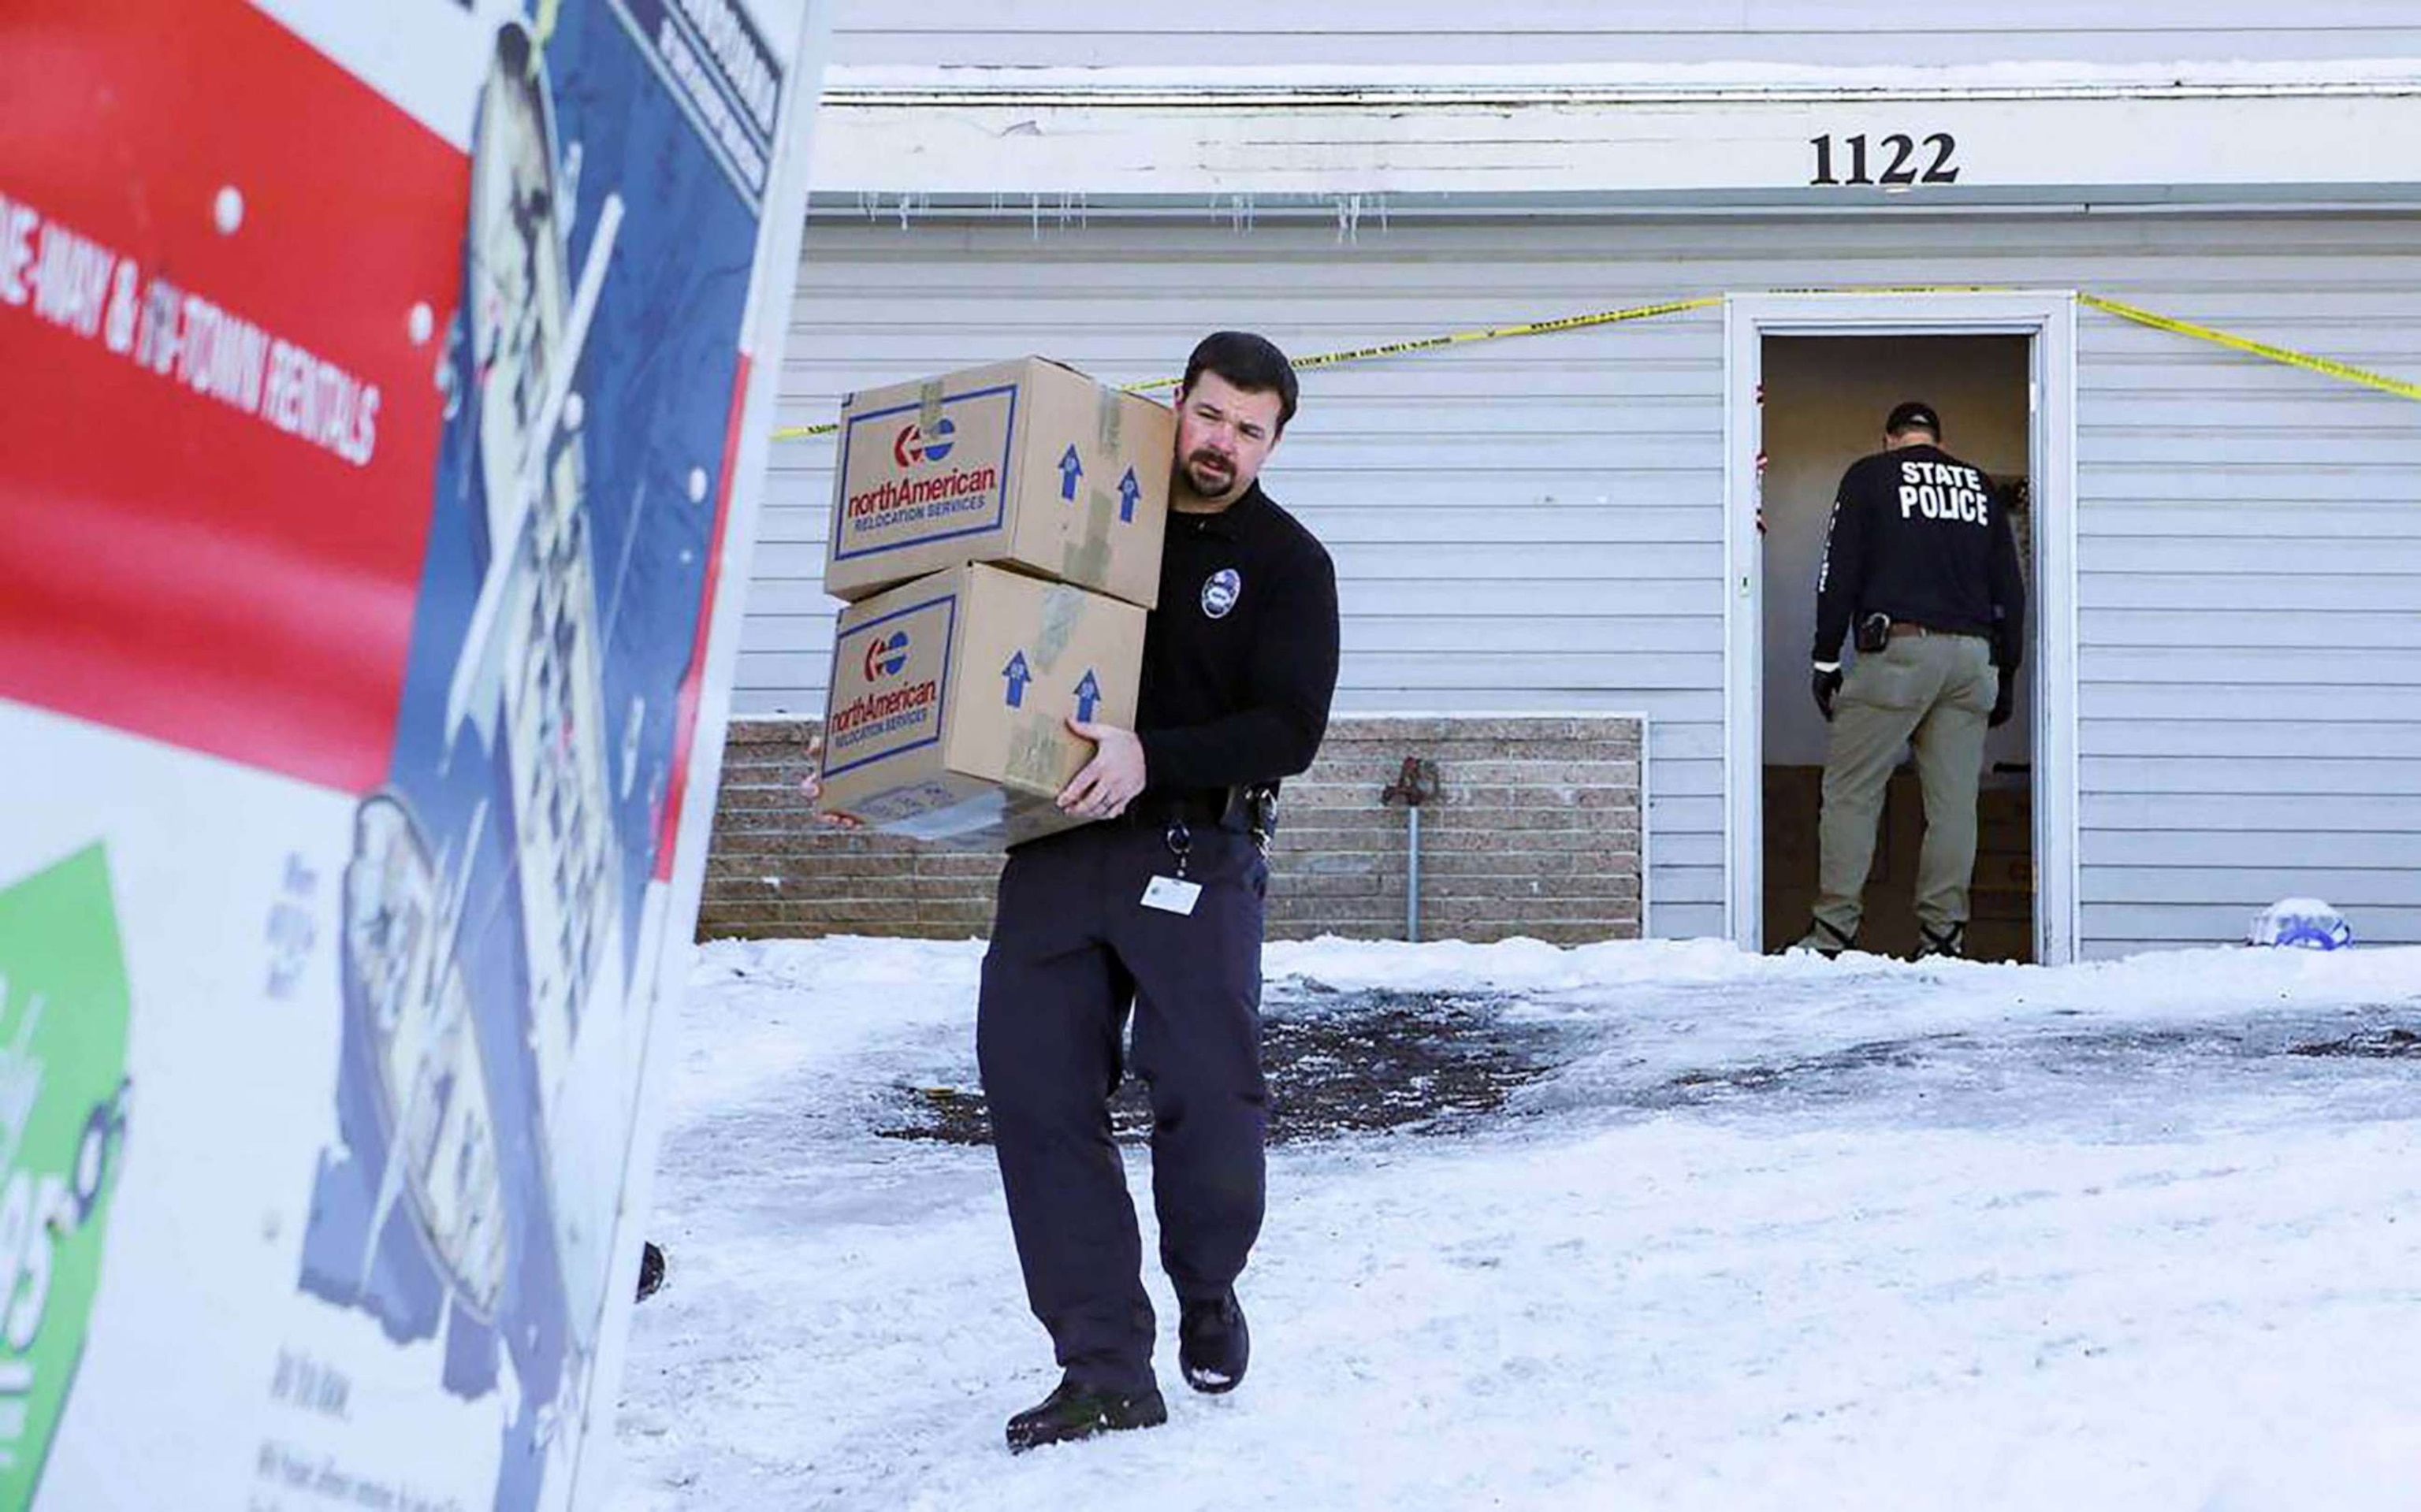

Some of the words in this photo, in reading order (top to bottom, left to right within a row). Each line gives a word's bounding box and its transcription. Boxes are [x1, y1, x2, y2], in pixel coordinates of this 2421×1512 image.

[1810, 133, 1960, 184] 1122
[0, 191, 117, 337] E-WAY
[106, 258, 139, 353] &
[260, 339, 381, 466] RENTALS
[848, 466, 995, 518] northAmerican
[1901, 461, 1981, 490] STATE
[855, 505, 924, 532] RELOCATION
[927, 494, 986, 518] SERVICES
[1898, 485, 1988, 526] POLICE
[831, 680, 935, 736] northAmerican
